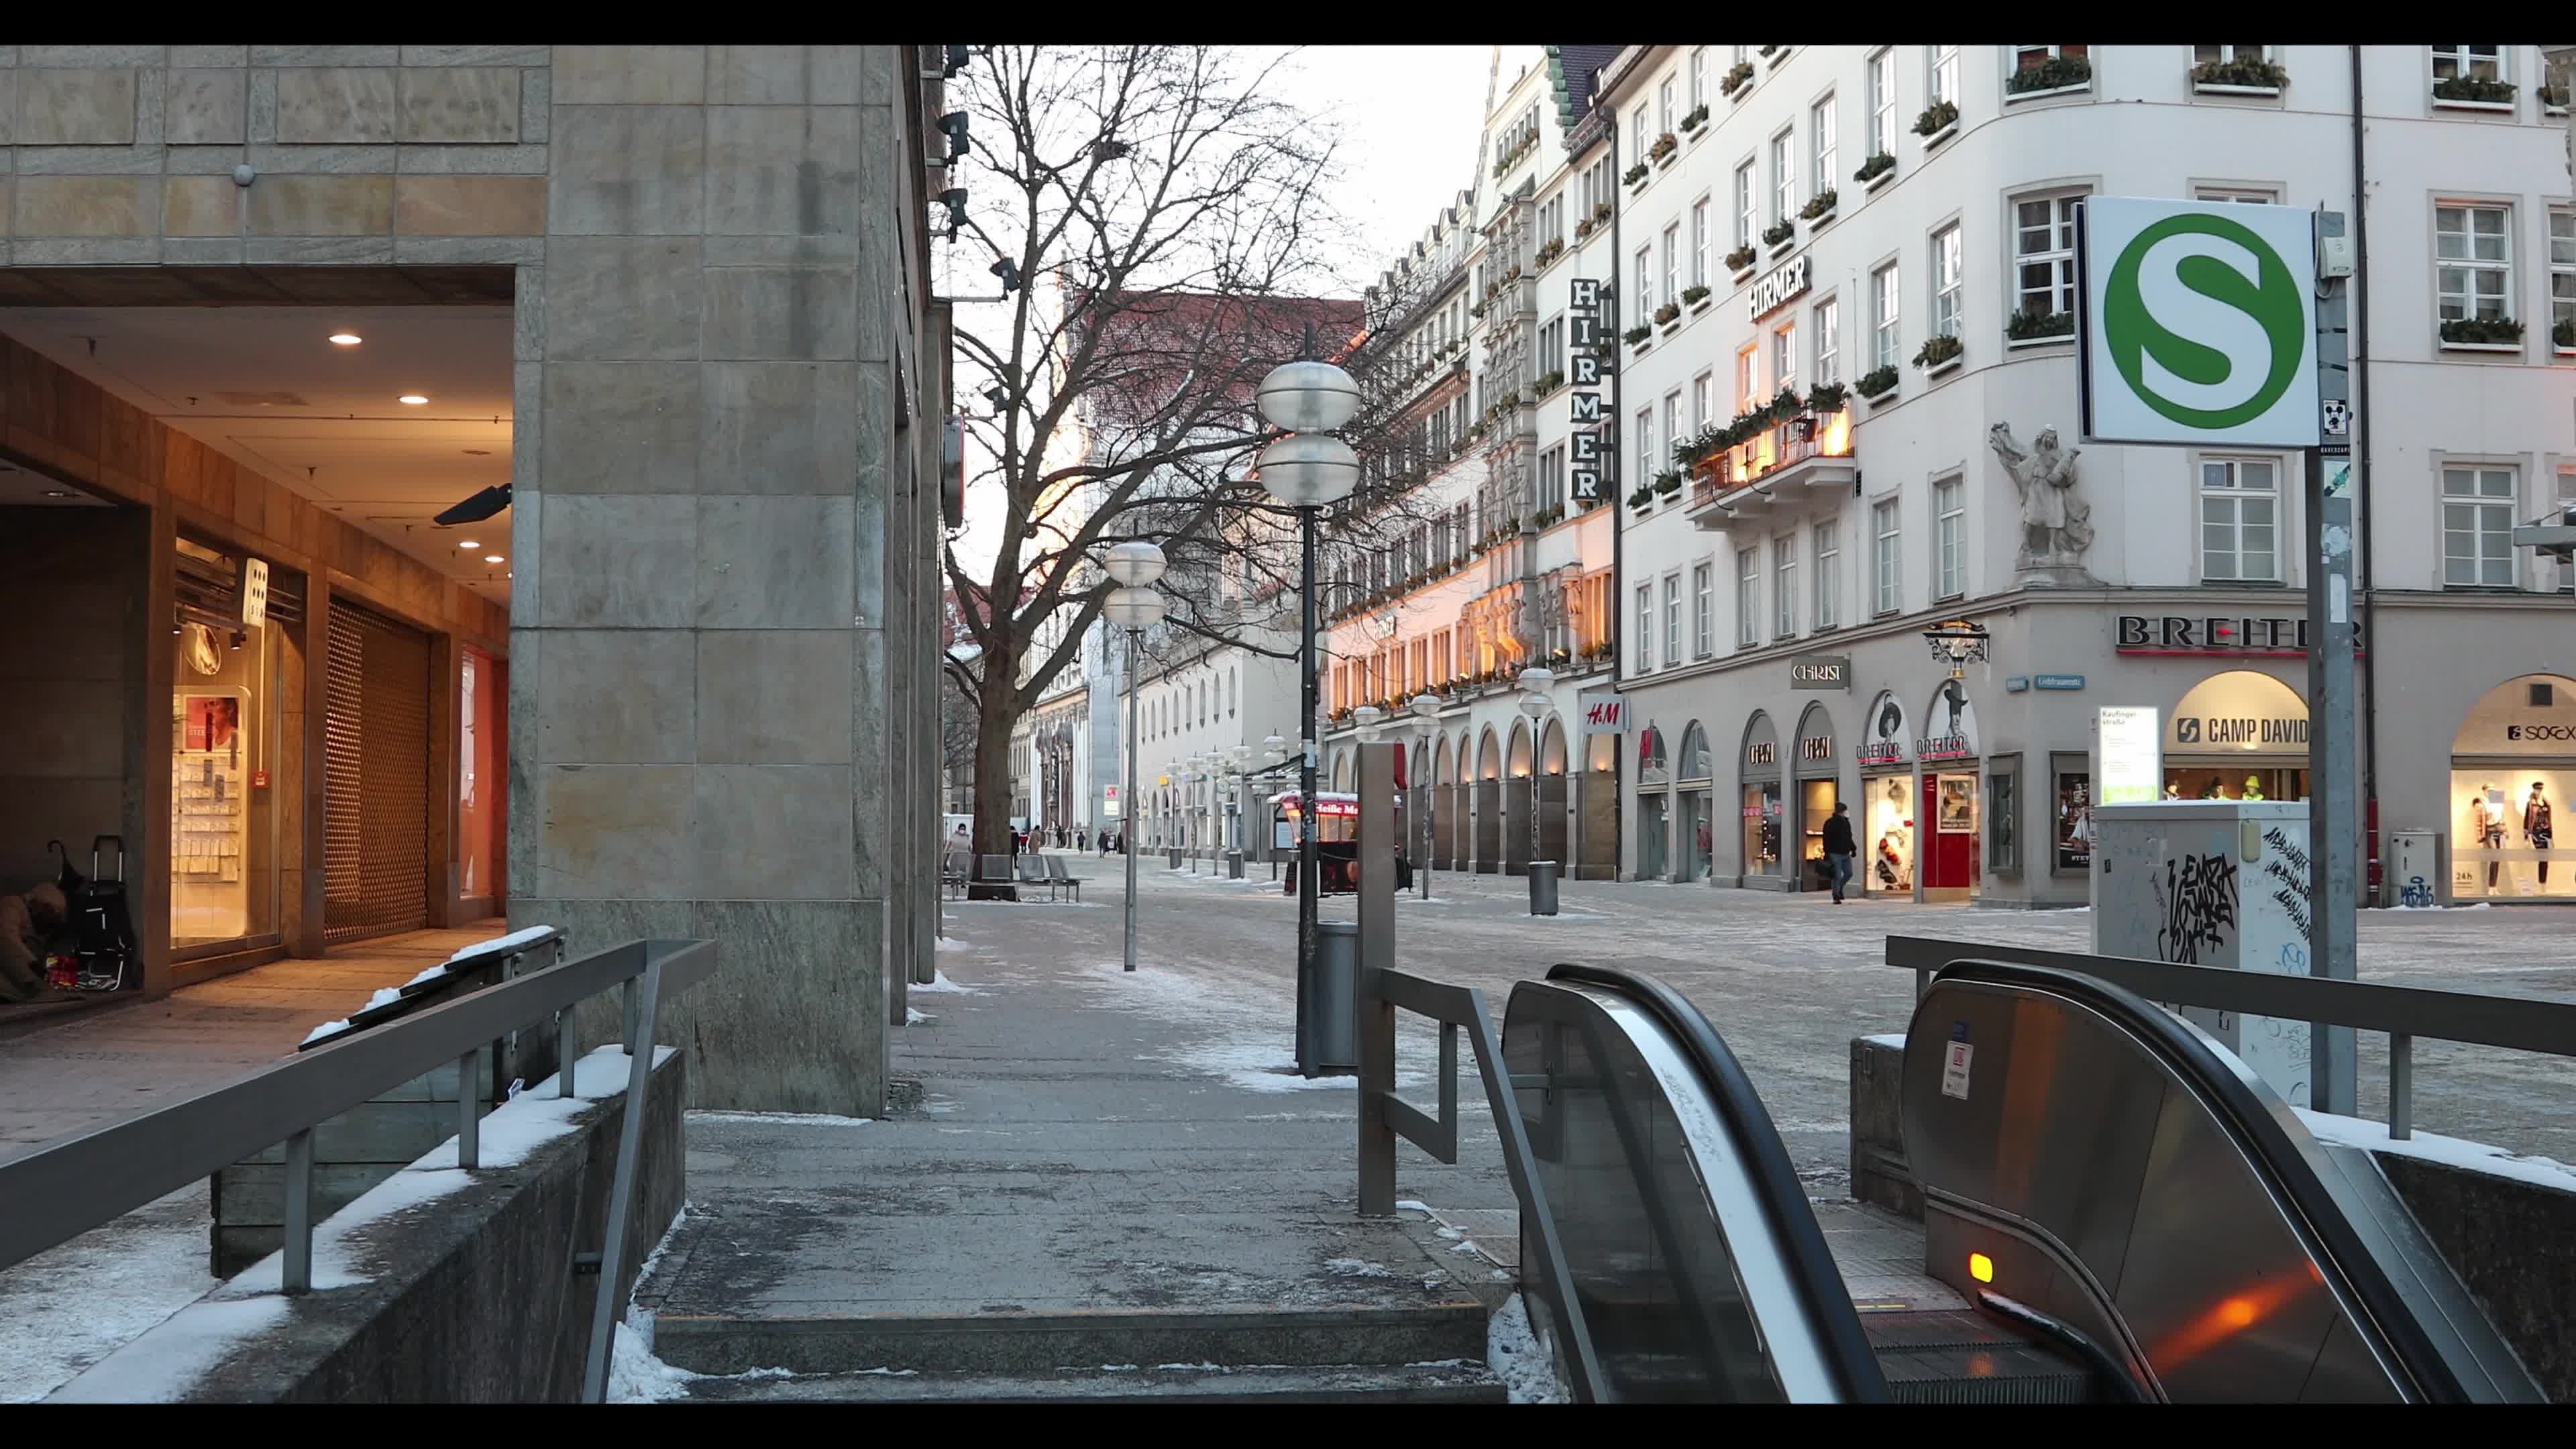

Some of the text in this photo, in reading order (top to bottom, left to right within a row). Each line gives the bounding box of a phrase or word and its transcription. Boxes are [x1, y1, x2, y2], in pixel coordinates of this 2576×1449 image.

[1749, 256, 1805, 322] HIRMER
[2137, 232, 2273, 412] S
[1573, 282, 1601, 497] HIRMER
[1793, 665, 1842, 680] CHRIST
[1587, 703, 1620, 724] H&M
[2208, 718, 2308, 743] CAMP DAVID
[1750, 743, 1774, 765] CHRIST
[1803, 736, 1831, 760] CHRIST
